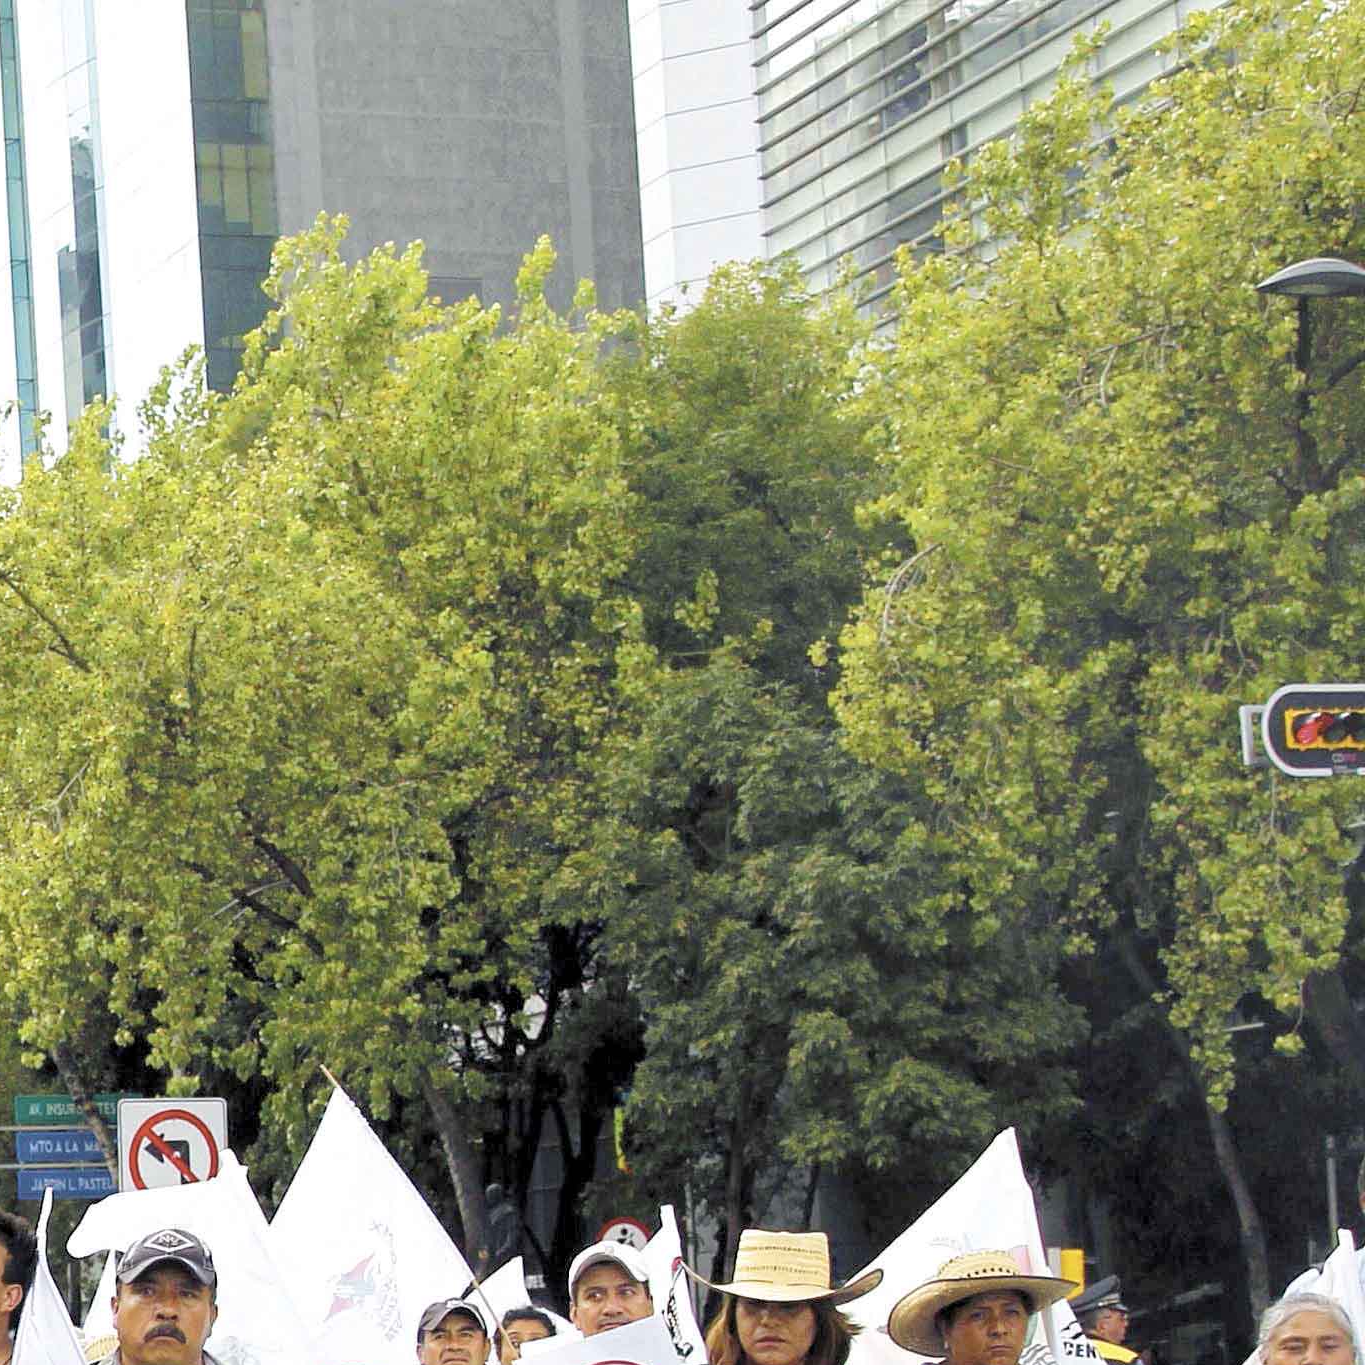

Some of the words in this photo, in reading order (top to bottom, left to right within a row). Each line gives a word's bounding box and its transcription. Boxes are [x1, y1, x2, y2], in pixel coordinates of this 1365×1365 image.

[29, 1140, 53, 1153] MTO
[54, 1141, 62, 1153] A
[65, 1141, 79, 1153] LA
